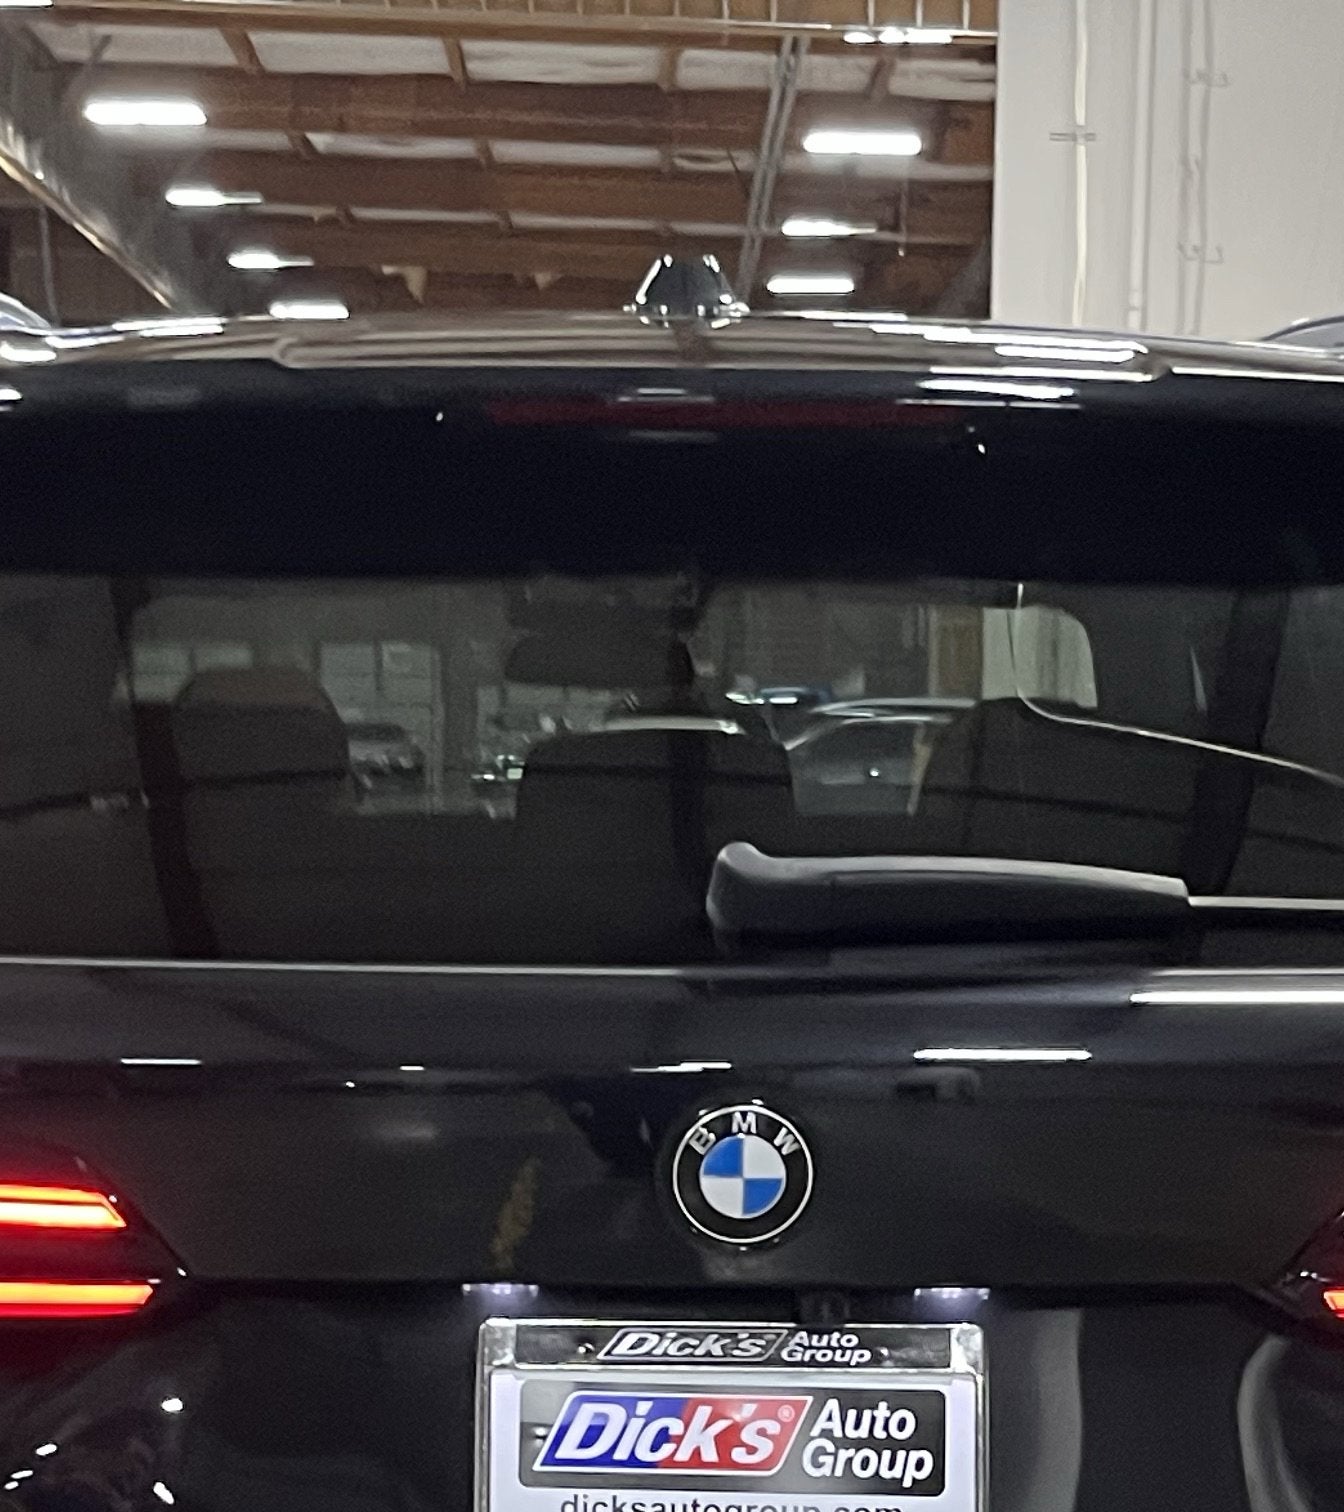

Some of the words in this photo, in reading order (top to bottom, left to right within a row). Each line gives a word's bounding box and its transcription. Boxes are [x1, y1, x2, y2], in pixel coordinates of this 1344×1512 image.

[688, 1111, 802, 1157] BMW
[610, 1331, 768, 1356] Dick's
[780, 1346, 872, 1365] Group
[787, 1331, 859, 1348] Auto
[555, 1401, 781, 1465] Dick's
[810, 1398, 916, 1440] Auto
[802, 1437, 933, 1488] Group
